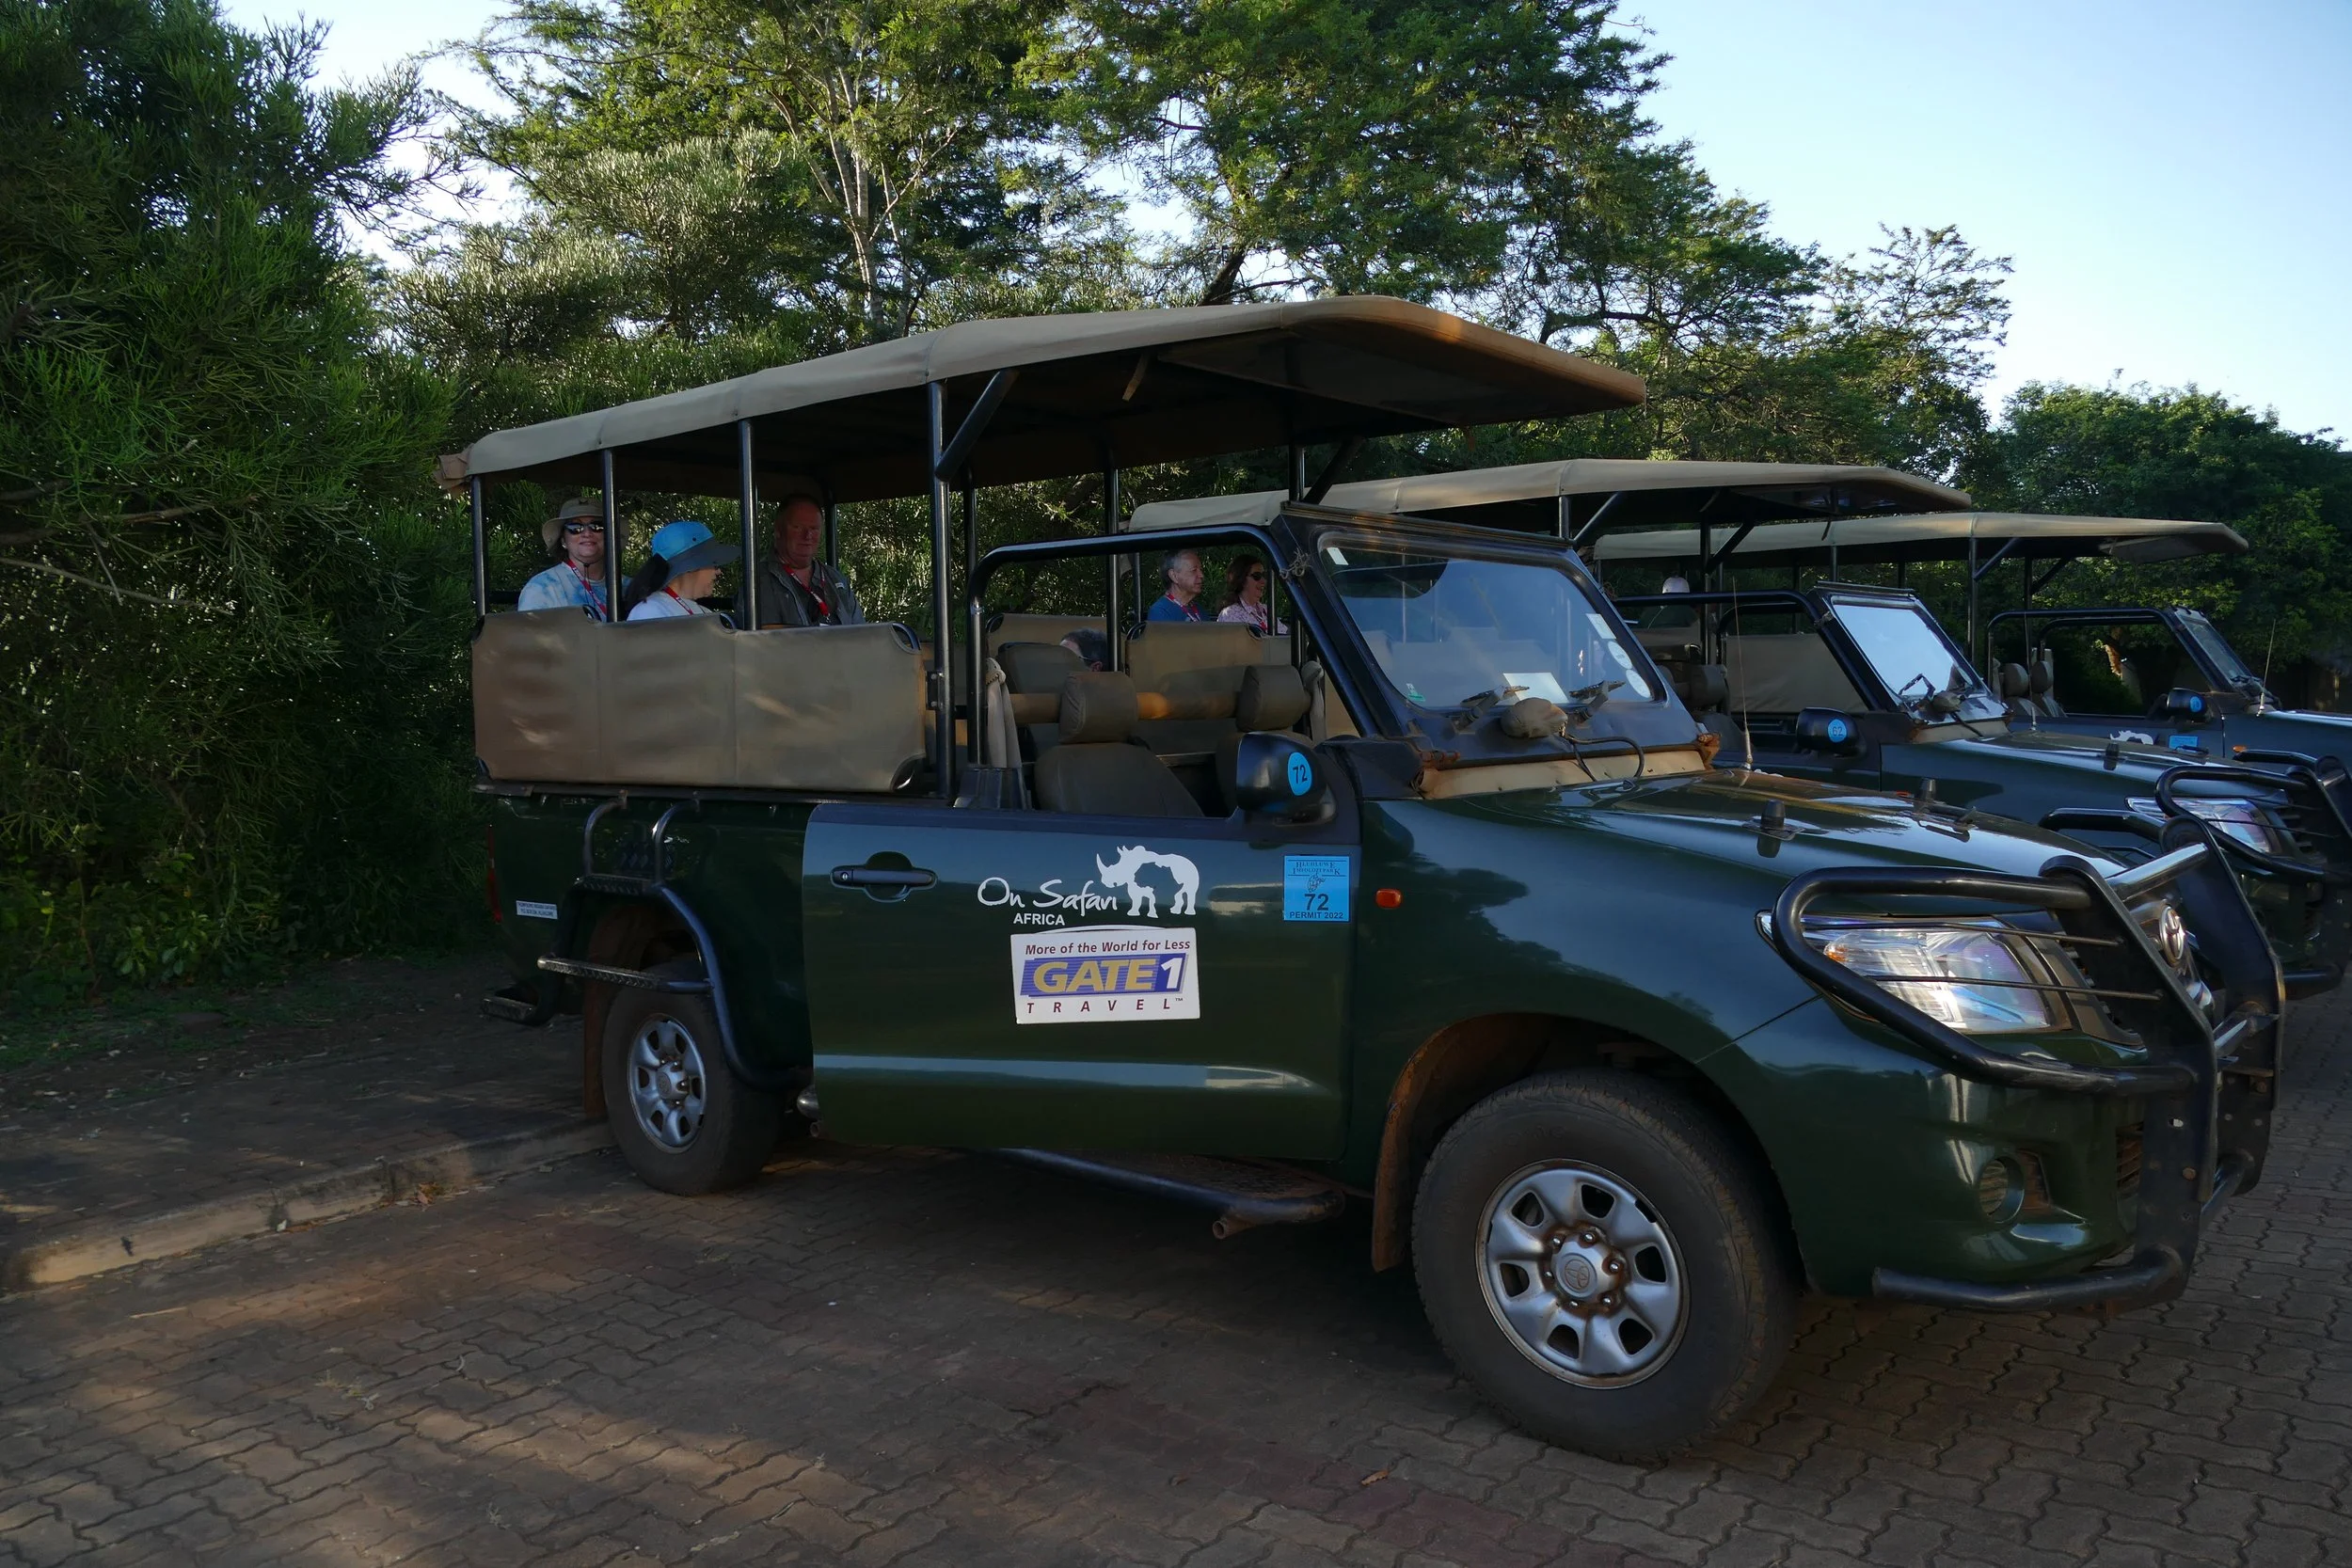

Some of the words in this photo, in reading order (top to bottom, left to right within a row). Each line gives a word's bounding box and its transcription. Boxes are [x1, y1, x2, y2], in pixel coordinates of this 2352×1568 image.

[1833, 725, 1843, 736] 62
[1293, 764, 1308, 784] 72
[977, 877, 1025, 908] On
[1033, 879, 1118, 917] Safari
[1304, 893, 1329, 911] 72
[1013, 912, 1066, 926] AFRICA
[1289, 911, 1322, 919] PERMIT
[1025, 944, 1056, 956] More
[1060, 943, 1073, 954] of
[1077, 942, 1097, 953] the
[1102, 941, 1138, 952] World
[1142, 940, 1161, 951] for
[1164, 940, 1191, 950] Less
[1026, 998, 1171, 1014] TRAVEL
